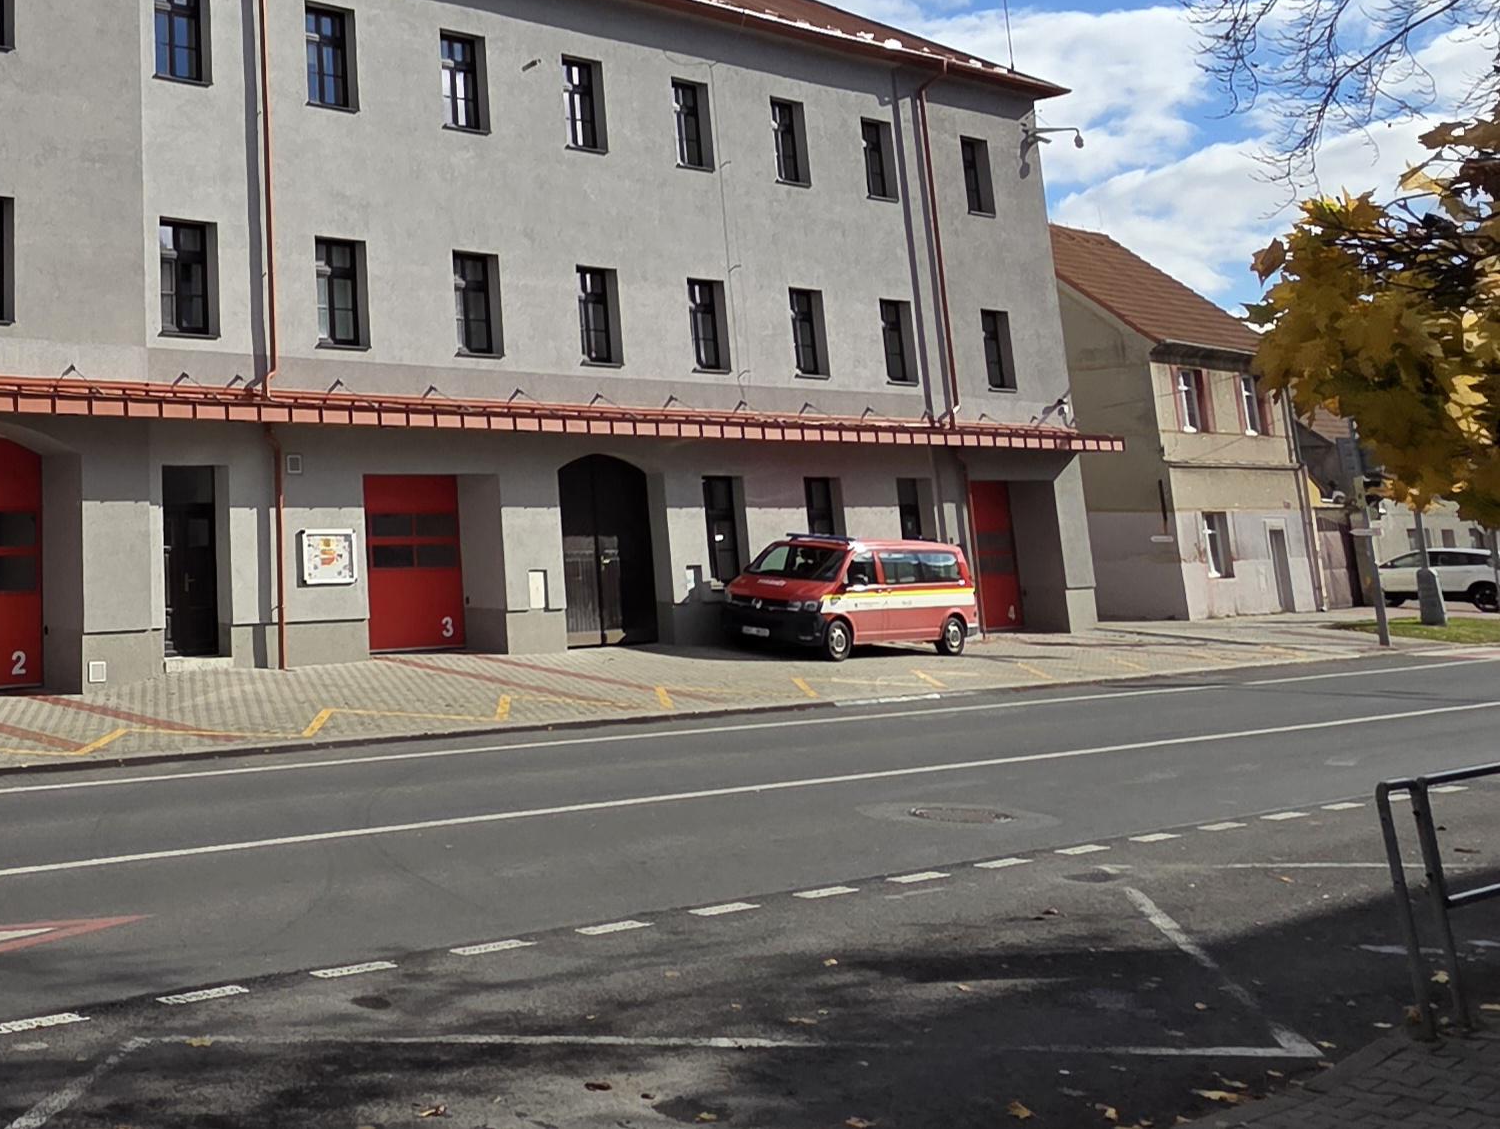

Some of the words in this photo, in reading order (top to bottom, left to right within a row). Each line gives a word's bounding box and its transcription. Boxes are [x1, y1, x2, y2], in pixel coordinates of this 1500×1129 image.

[1008, 605, 1016, 620] 4
[442, 616, 454, 637] 3
[11, 650, 26, 675] 2
